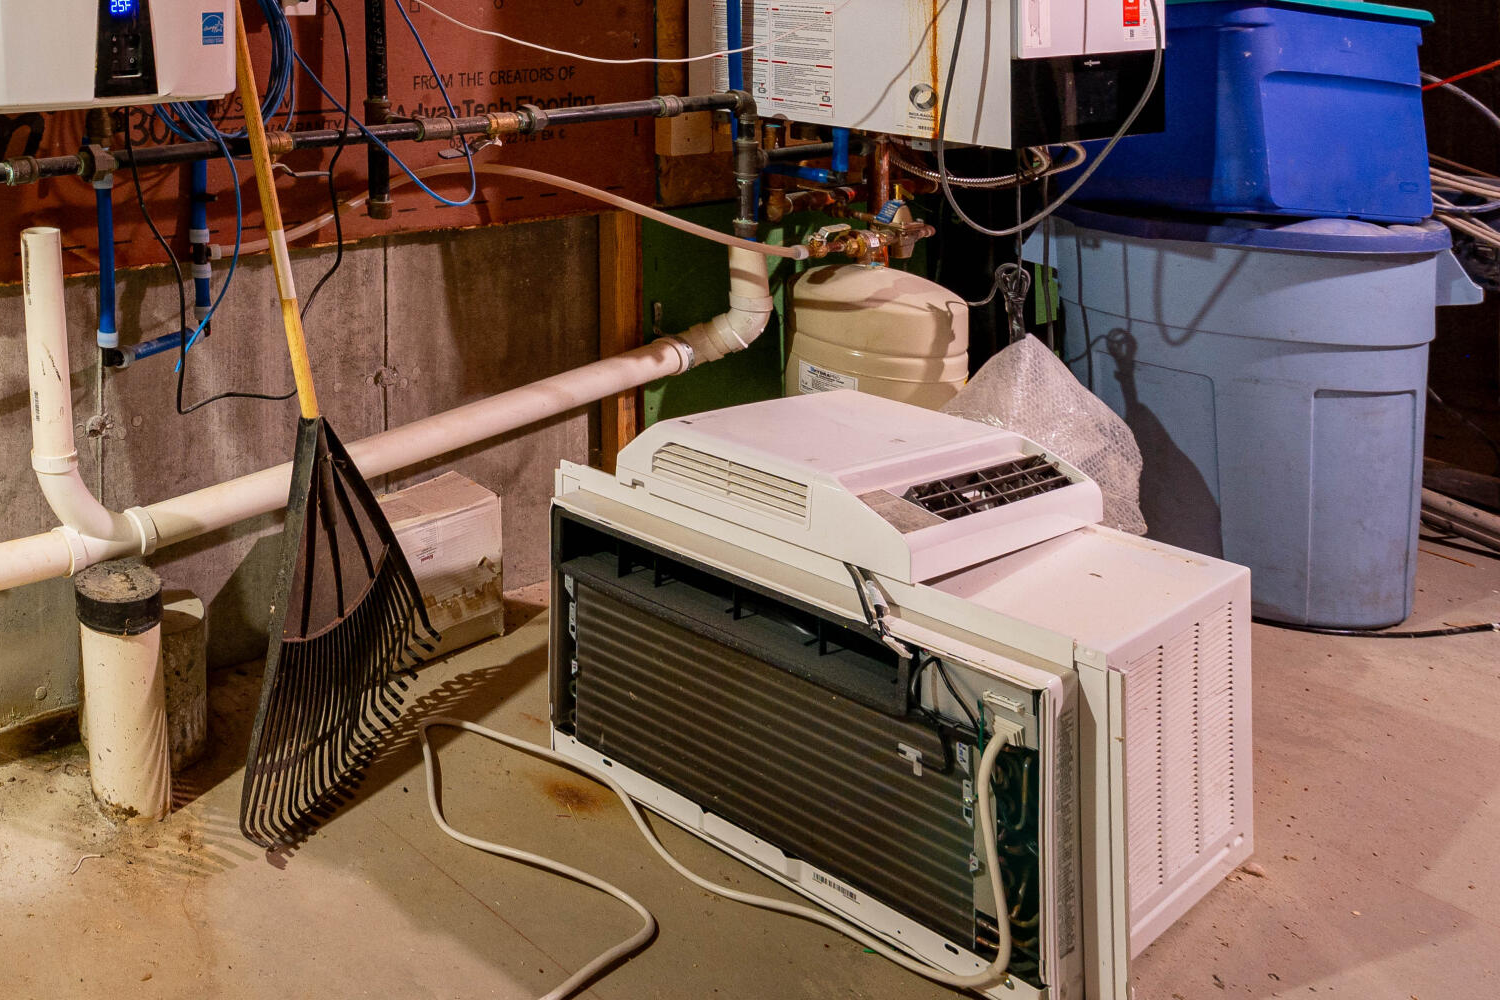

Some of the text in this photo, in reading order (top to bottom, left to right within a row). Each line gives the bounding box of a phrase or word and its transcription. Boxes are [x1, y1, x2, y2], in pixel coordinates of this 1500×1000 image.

[413, 66, 575, 90] FROM THE CREATORS OF
